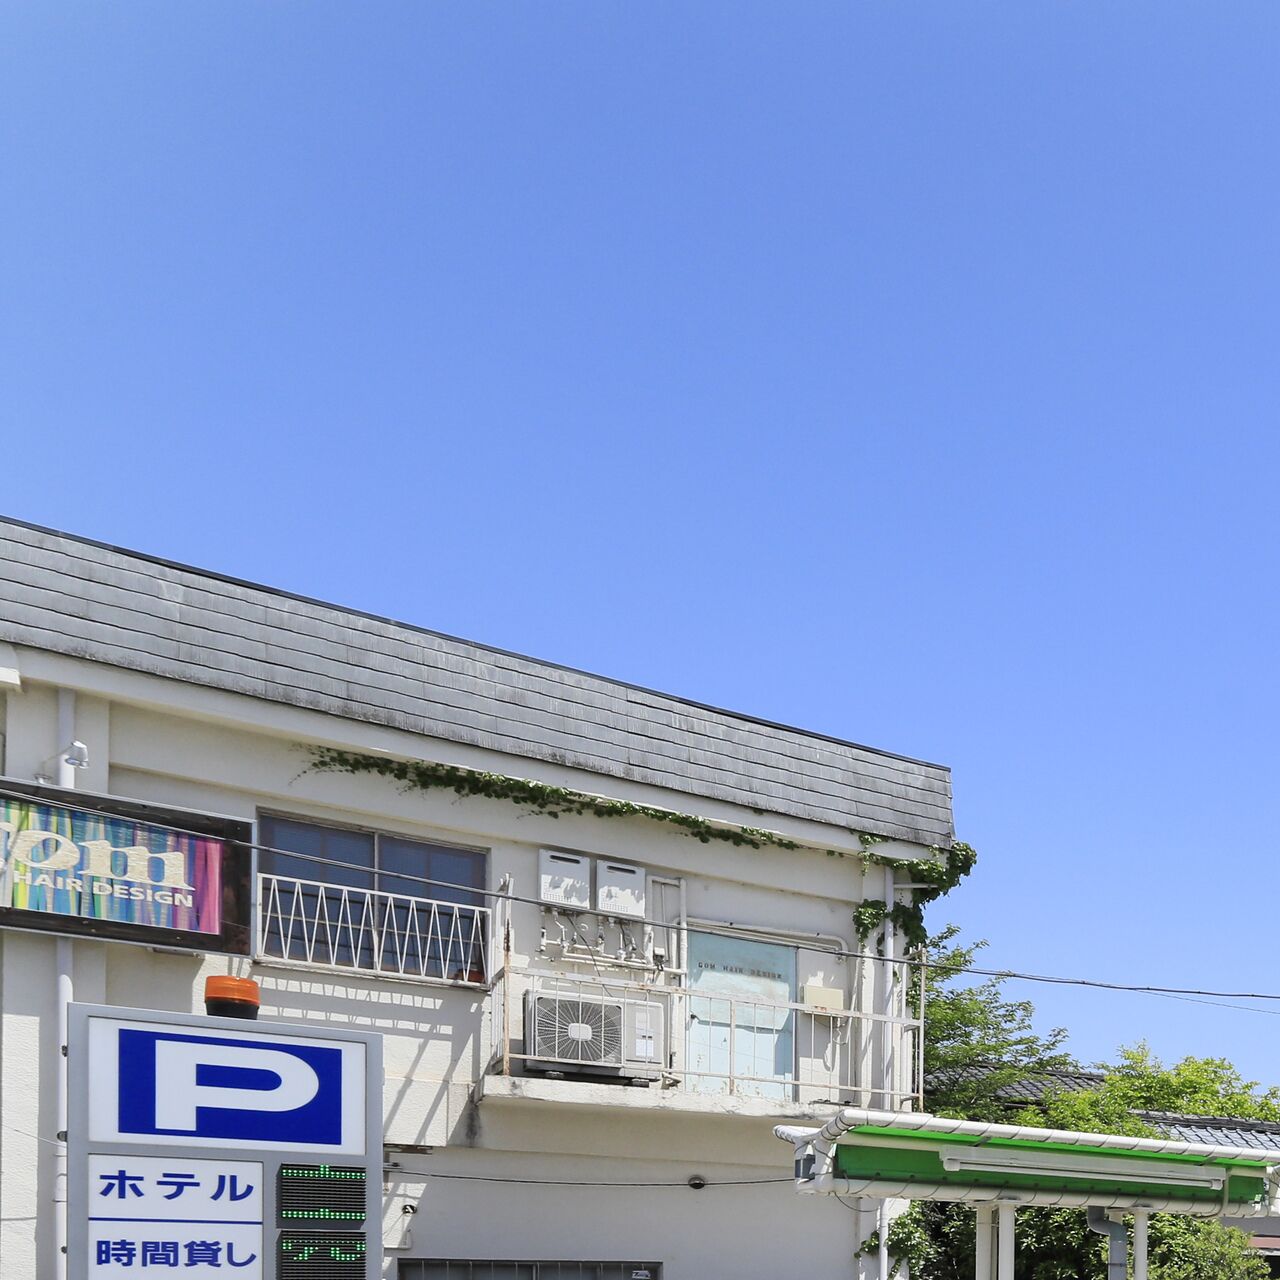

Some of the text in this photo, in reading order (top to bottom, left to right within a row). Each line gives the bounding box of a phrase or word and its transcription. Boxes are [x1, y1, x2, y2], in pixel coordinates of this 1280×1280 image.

[0, 821, 196, 890] om
[13, 870, 193, 908] HAIR DESIGN
[155, 1040, 320, 1132] P
[99, 1170, 255, 1202] ホテル
[96, 1240, 257, 1268] 時間貸し
